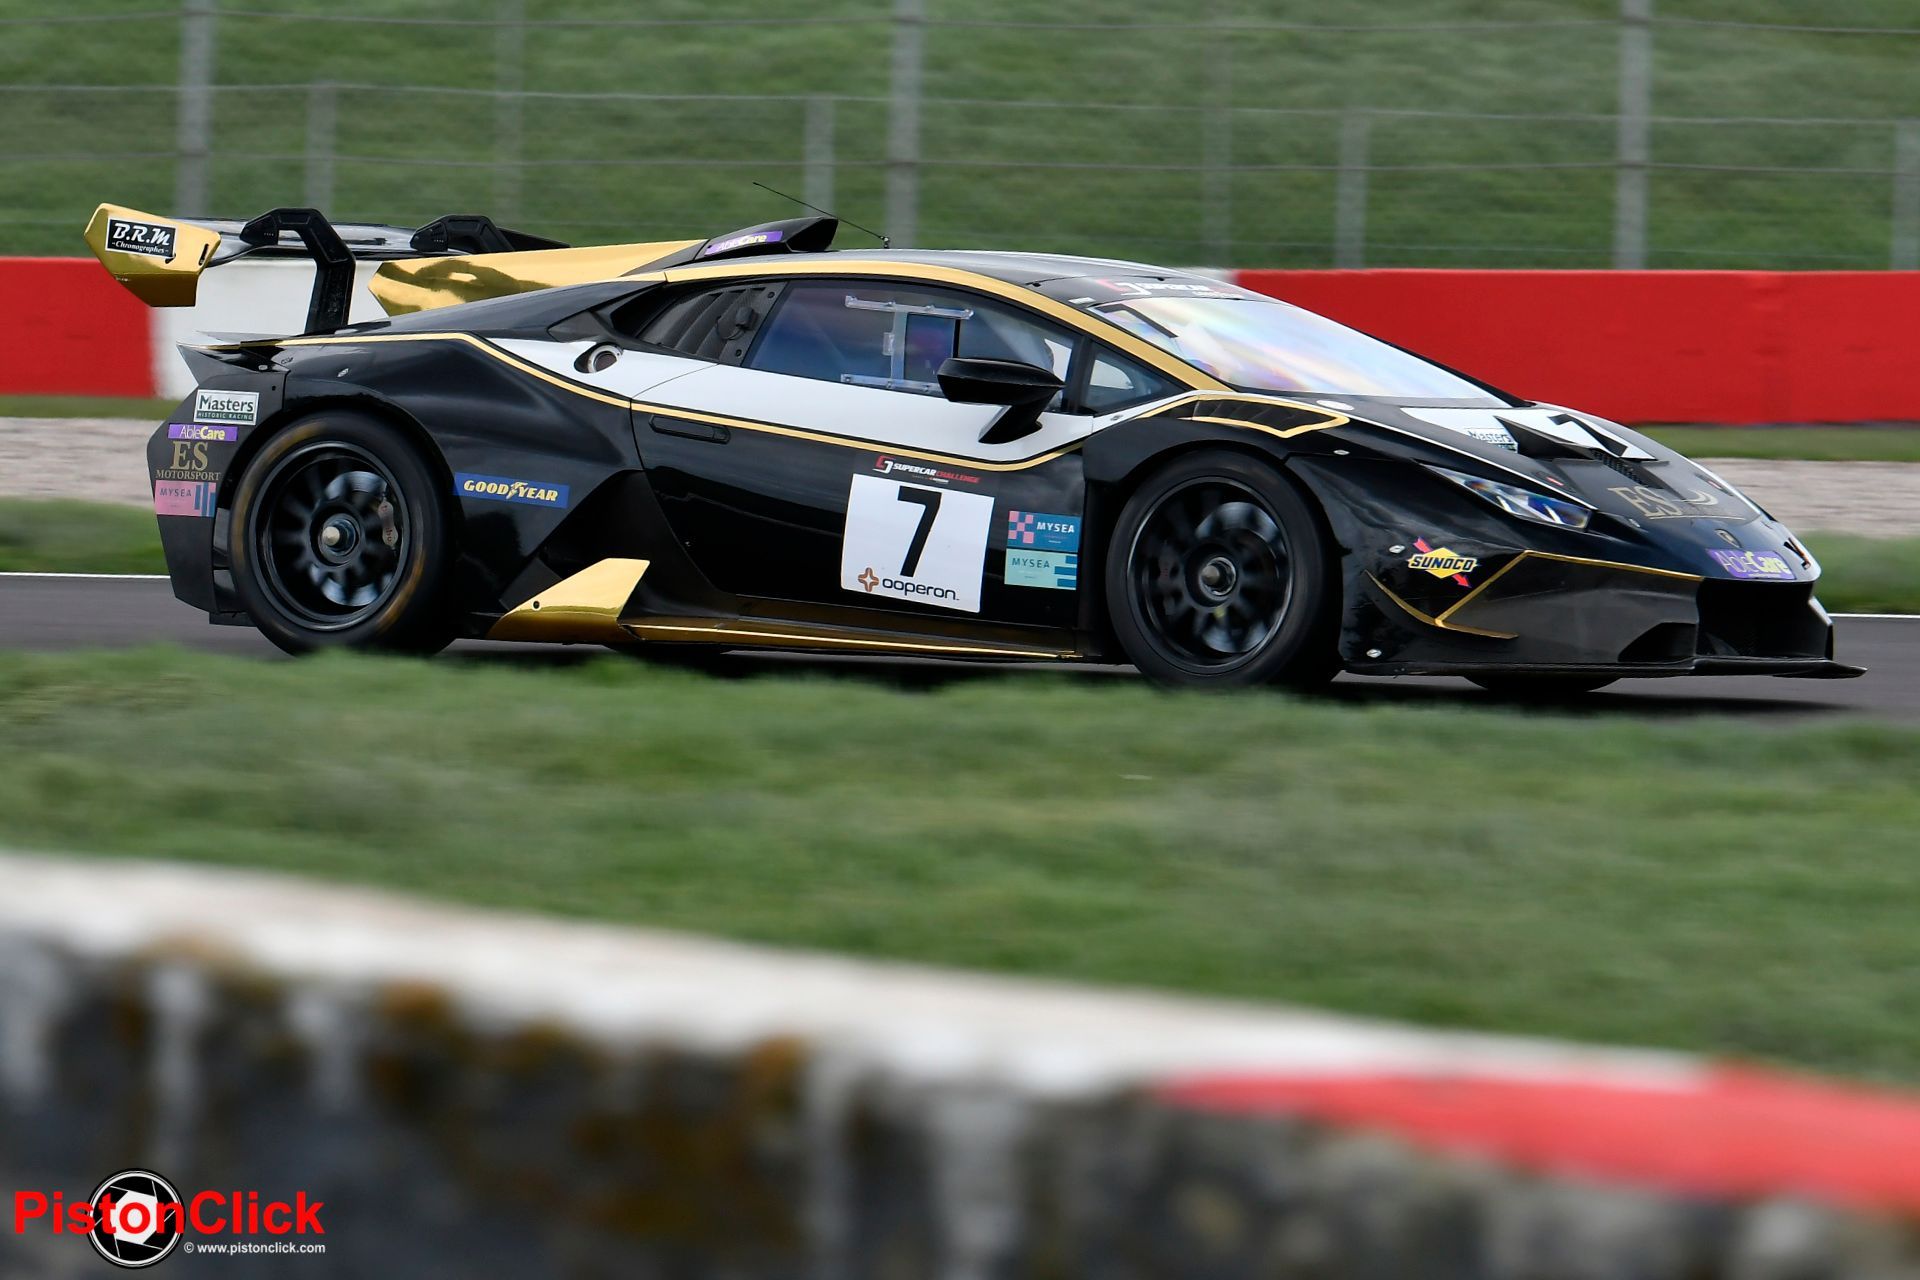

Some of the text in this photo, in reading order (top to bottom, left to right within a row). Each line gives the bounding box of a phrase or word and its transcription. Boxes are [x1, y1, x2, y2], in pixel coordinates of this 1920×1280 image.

[112, 222, 171, 246] B.R.M
[199, 394, 254, 413] Masters
[197, 411, 253, 421] HISTORIC RACING
[180, 425, 226, 441] AbleCare
[1547, 413, 1628, 458] 7
[169, 440, 209, 472] ES
[155, 469, 221, 482] MOTORSPORT
[160, 487, 192, 498] MYSEA
[463, 479, 559, 502] GOODYEAR
[1606, 485, 1683, 518] ES
[897, 485, 943, 578] 7
[1036, 521, 1076, 534] MYSEA
[1011, 557, 1051, 569] MYSEA
[1410, 555, 1475, 572] SUNOCO
[882, 578, 956, 601] ooperon
